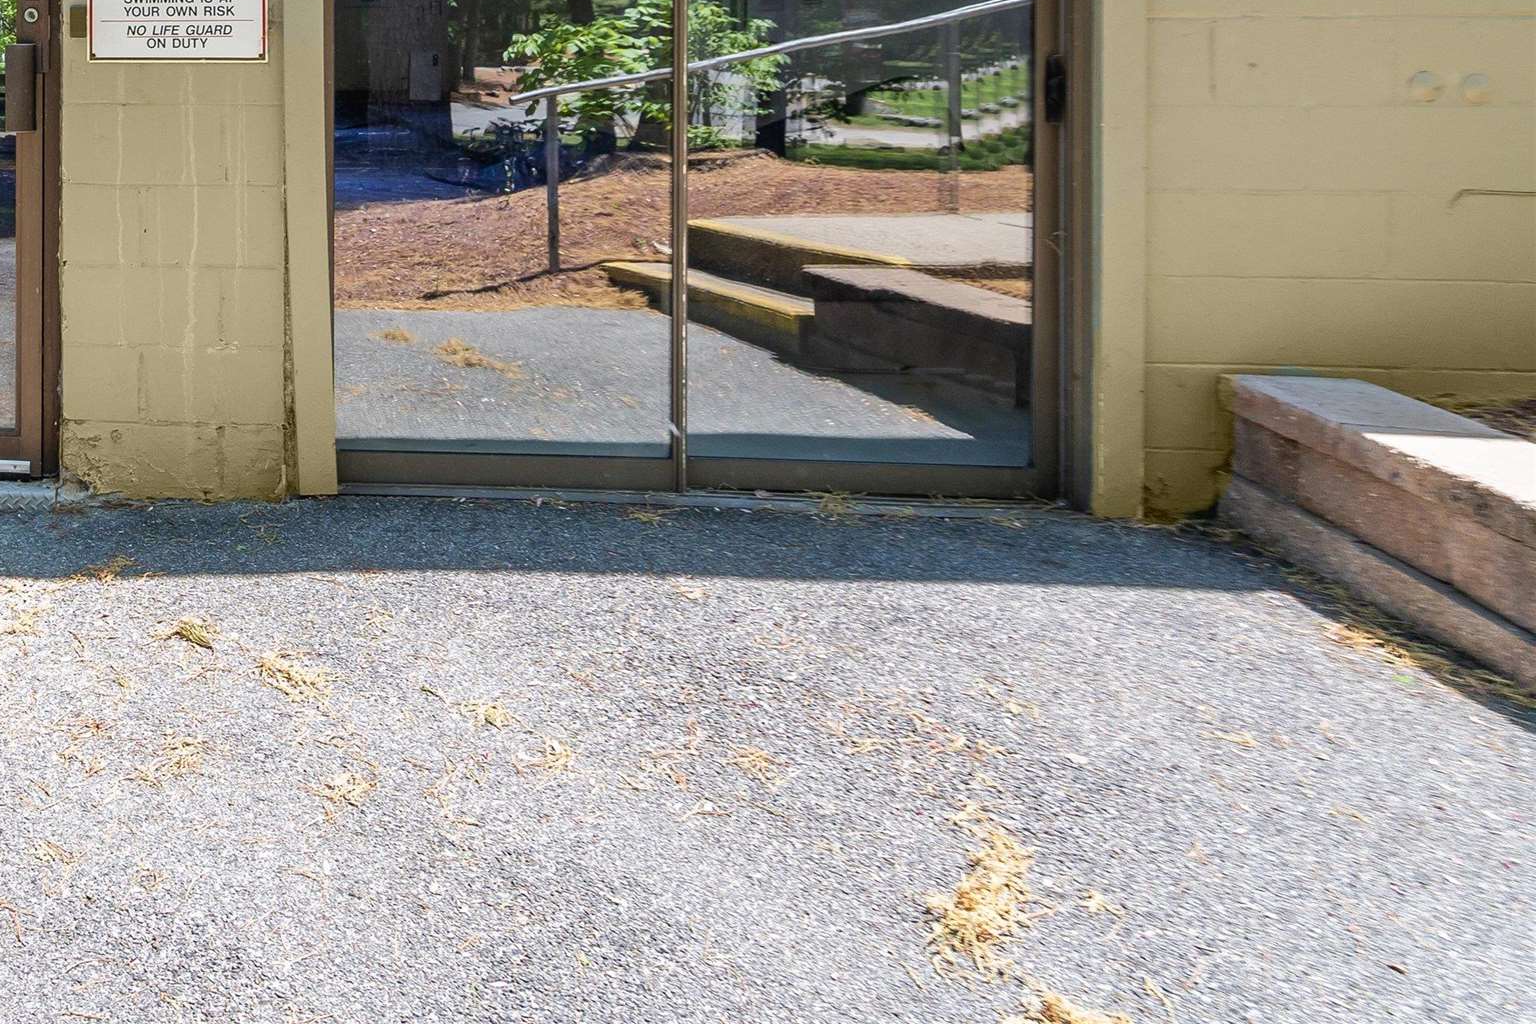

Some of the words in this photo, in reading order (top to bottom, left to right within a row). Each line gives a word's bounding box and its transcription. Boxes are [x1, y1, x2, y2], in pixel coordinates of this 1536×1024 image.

[124, 7, 160, 16] YOUR
[166, 7, 197, 16] OWN
[204, 7, 235, 16] RISK
[127, 26, 146, 35] NO
[153, 26, 179, 35] LIFE
[186, 25, 232, 35] GUARD
[147, 39, 165, 48] ON
[172, 38, 208, 48] DUTY
